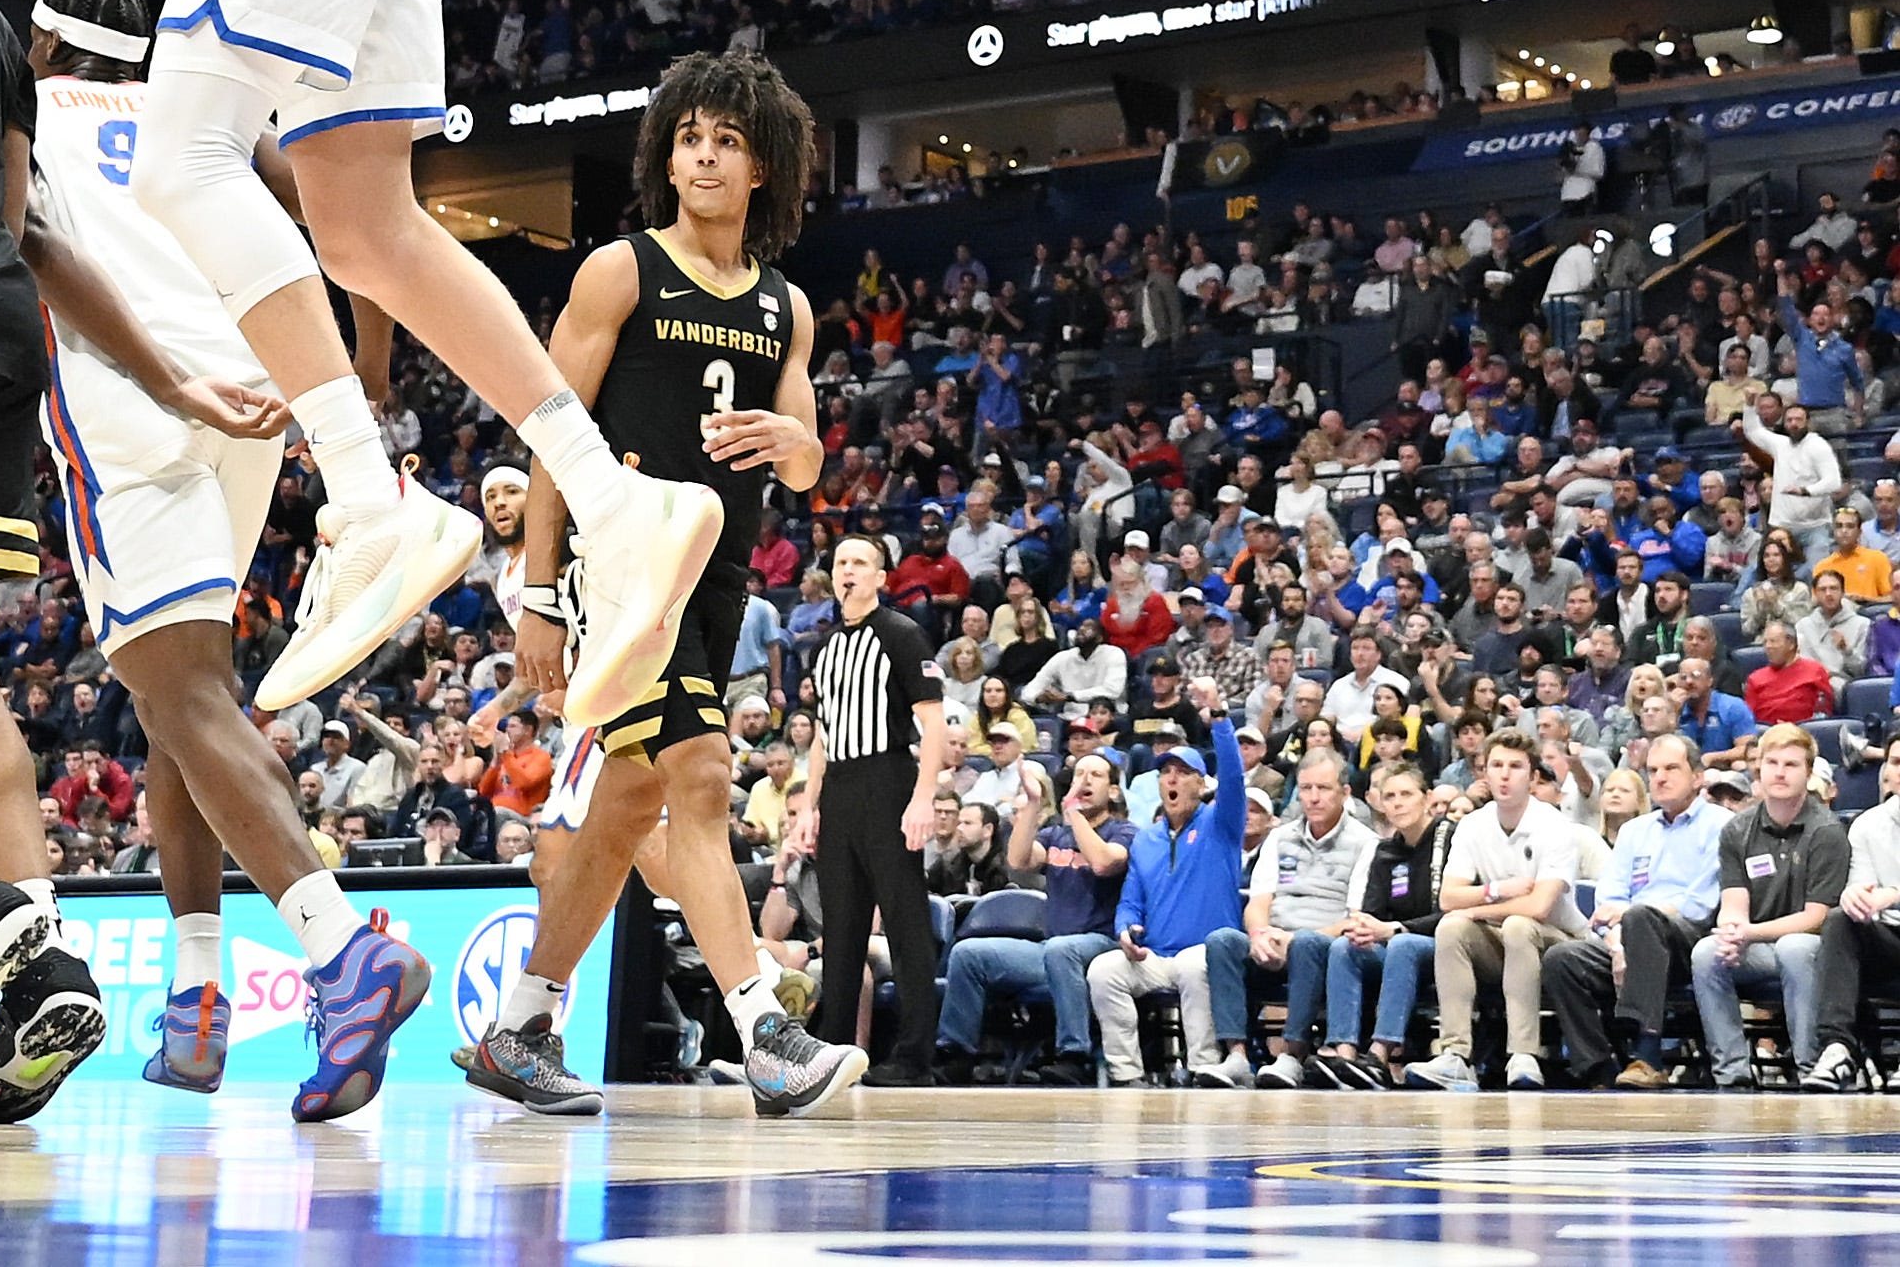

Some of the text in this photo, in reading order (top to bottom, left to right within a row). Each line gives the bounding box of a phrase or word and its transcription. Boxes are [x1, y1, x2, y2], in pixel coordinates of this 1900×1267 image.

[51, 90, 145, 113] CHINYE
[98, 120, 137, 186] 9
[1216, 155, 1240, 174] V
[655, 319, 782, 361] VANDERBILT
[700, 358, 735, 442] 3
